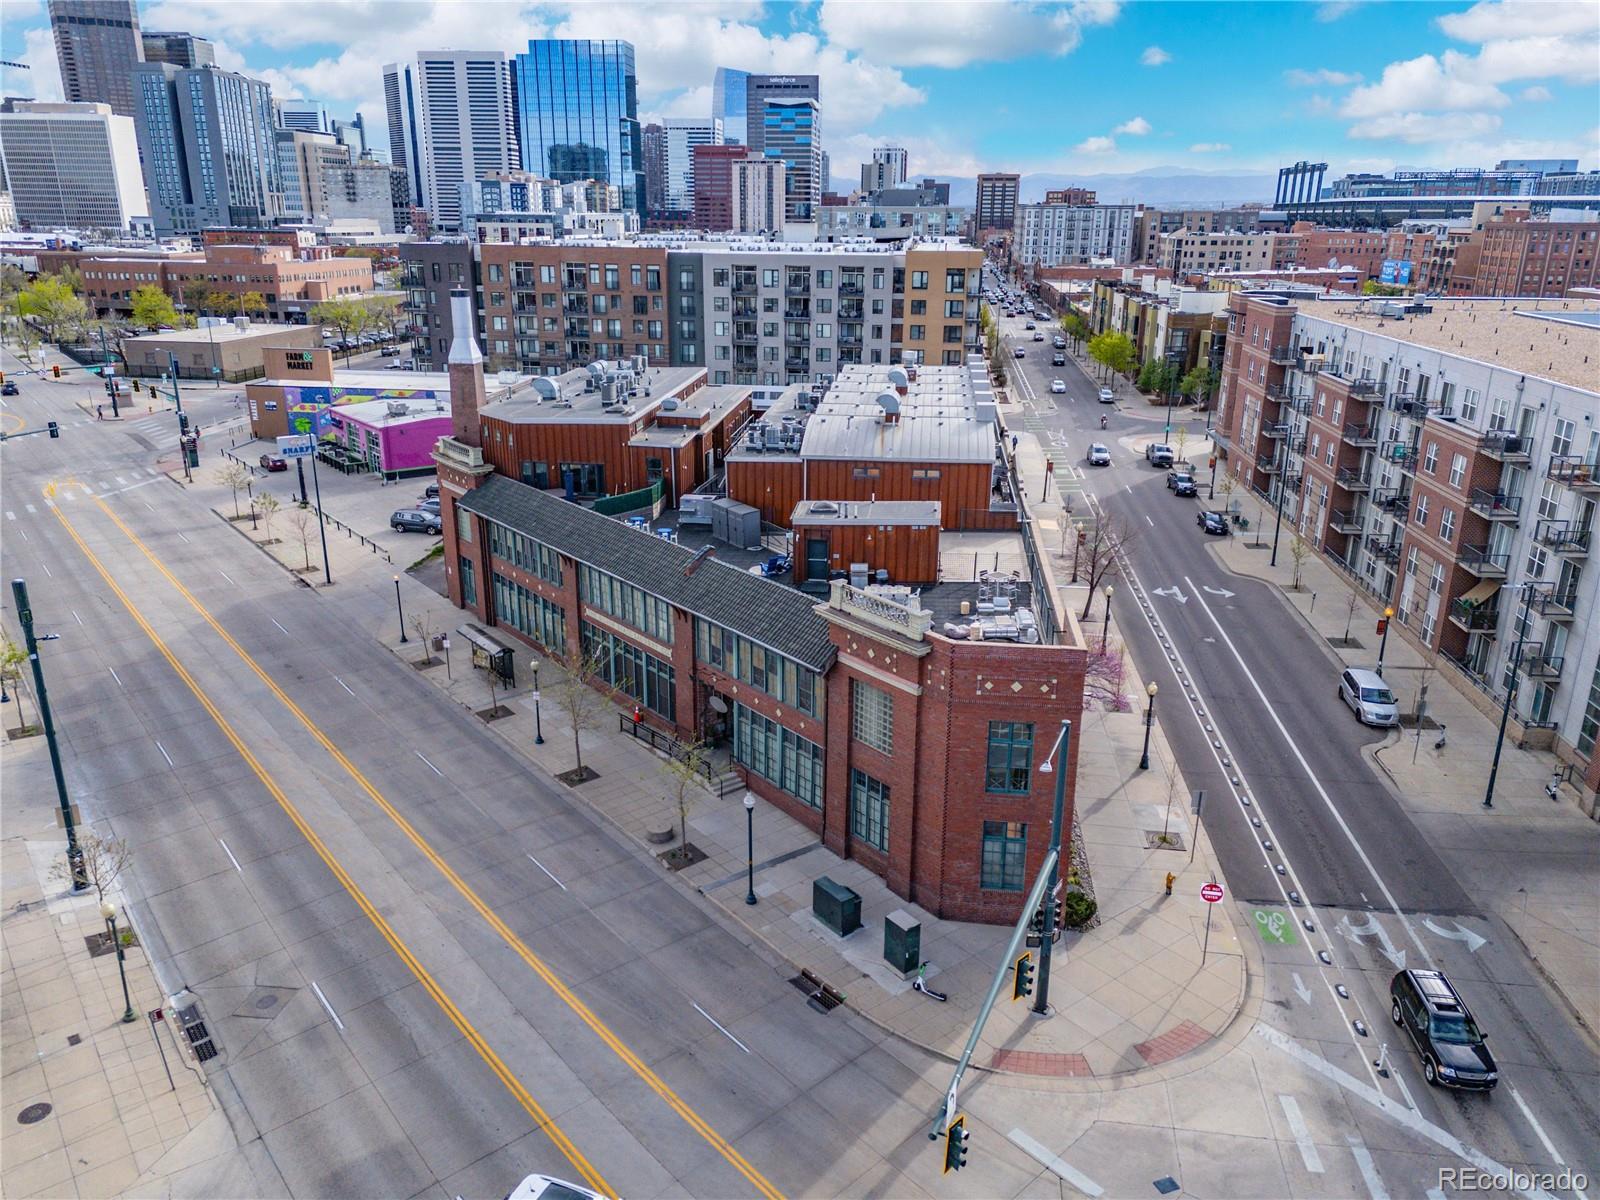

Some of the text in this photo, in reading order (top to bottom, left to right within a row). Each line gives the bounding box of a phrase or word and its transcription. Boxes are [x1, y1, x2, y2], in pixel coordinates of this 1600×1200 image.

[769, 76, 795, 84] salesforce
[287, 361, 313, 370] MARKET
[249, 399, 258, 420] MARKET
